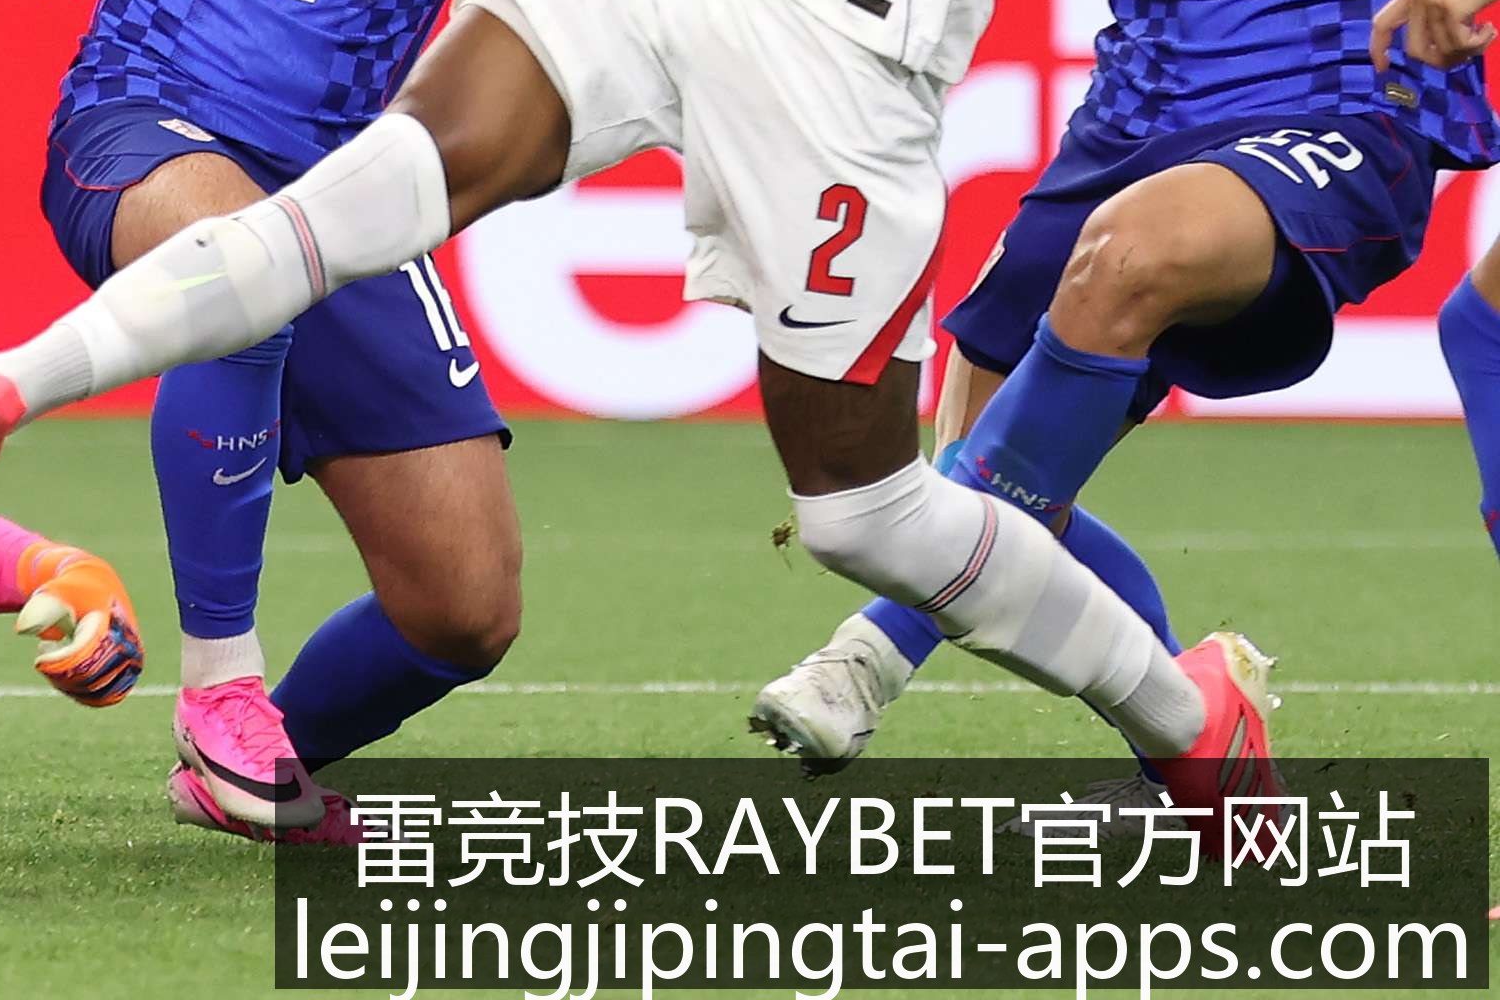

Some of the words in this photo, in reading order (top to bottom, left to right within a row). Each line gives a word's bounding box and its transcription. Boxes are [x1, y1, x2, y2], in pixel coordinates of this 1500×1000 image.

[805, 183, 869, 297] 2
[217, 428, 268, 451] HNS
[991, 472, 1051, 511] HNS
